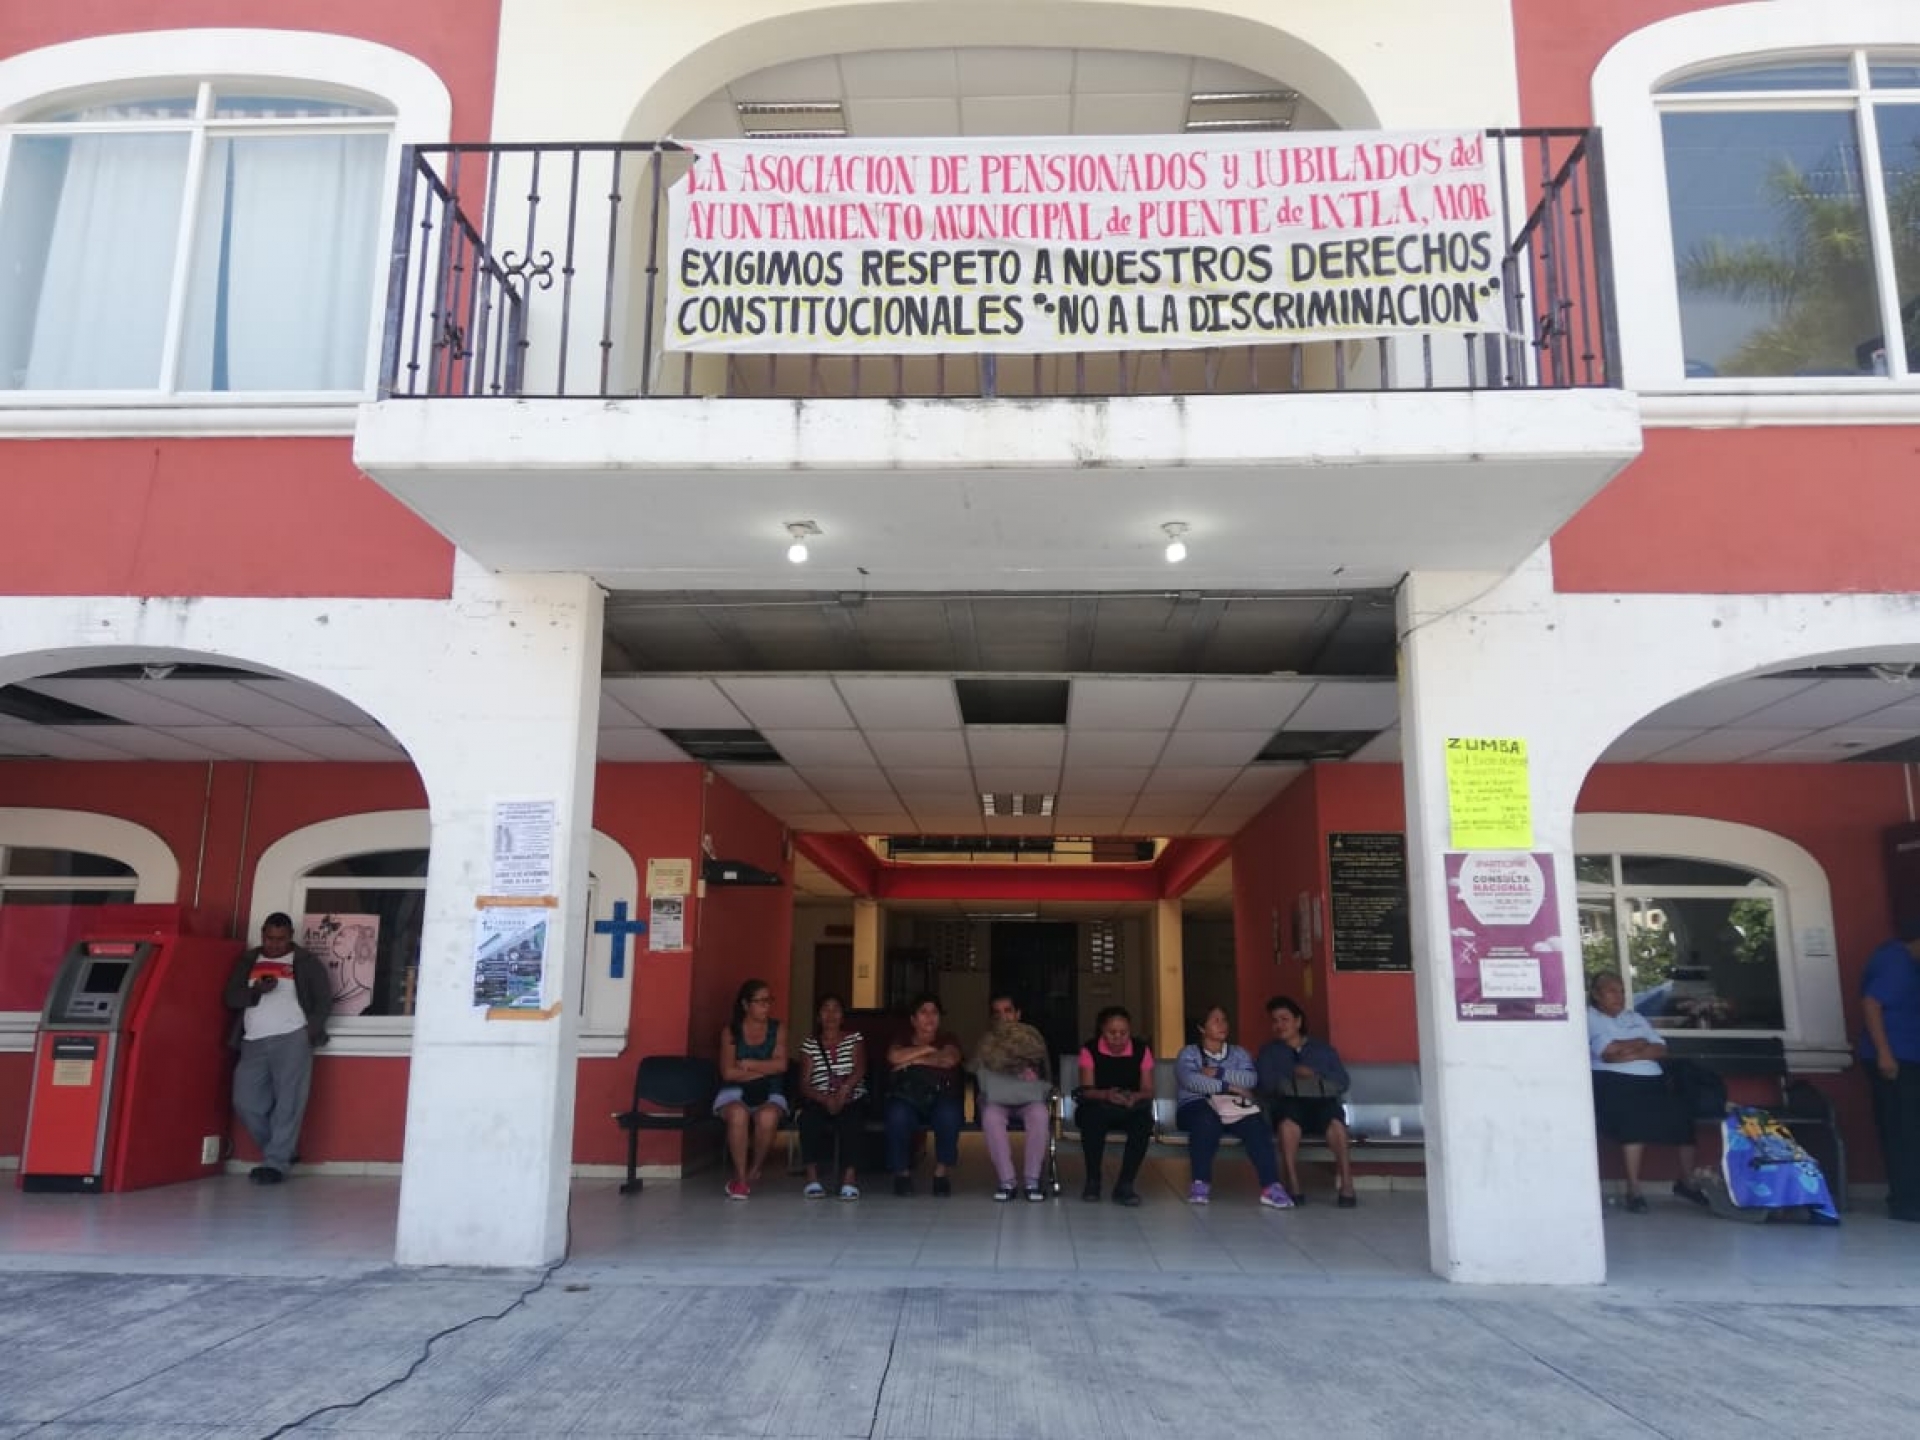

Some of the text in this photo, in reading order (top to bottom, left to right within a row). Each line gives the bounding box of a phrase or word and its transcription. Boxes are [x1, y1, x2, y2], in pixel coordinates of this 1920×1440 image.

[686, 152, 727, 194] LA
[740, 154, 916, 195] ASOCIACION
[930, 155, 971, 194] DE
[980, 151, 1207, 194] PENSIONADOS
[1248, 143, 1442, 189] JUBILADOS
[1450, 132, 1483, 172] del
[684, 202, 923, 241] AYUNTAMIENTO
[931, 200, 1101, 242] MUNICIPAL
[1106, 207, 1131, 236] de
[1138, 199, 1272, 240] PUENTE
[1276, 196, 1304, 227] de
[1432, 182, 1494, 223] MOR
[681, 230, 1492, 287] EXIGIMOS RESPETO A NUESTROS DERECHOS
[677, 295, 1024, 336] CONSTITUCIONALES
[1107, 294, 1128, 335] A
[1137, 294, 1179, 334] LA
[1447, 737, 1520, 754] ZUMBA
[1472, 875, 1531, 883] CONSULTA
